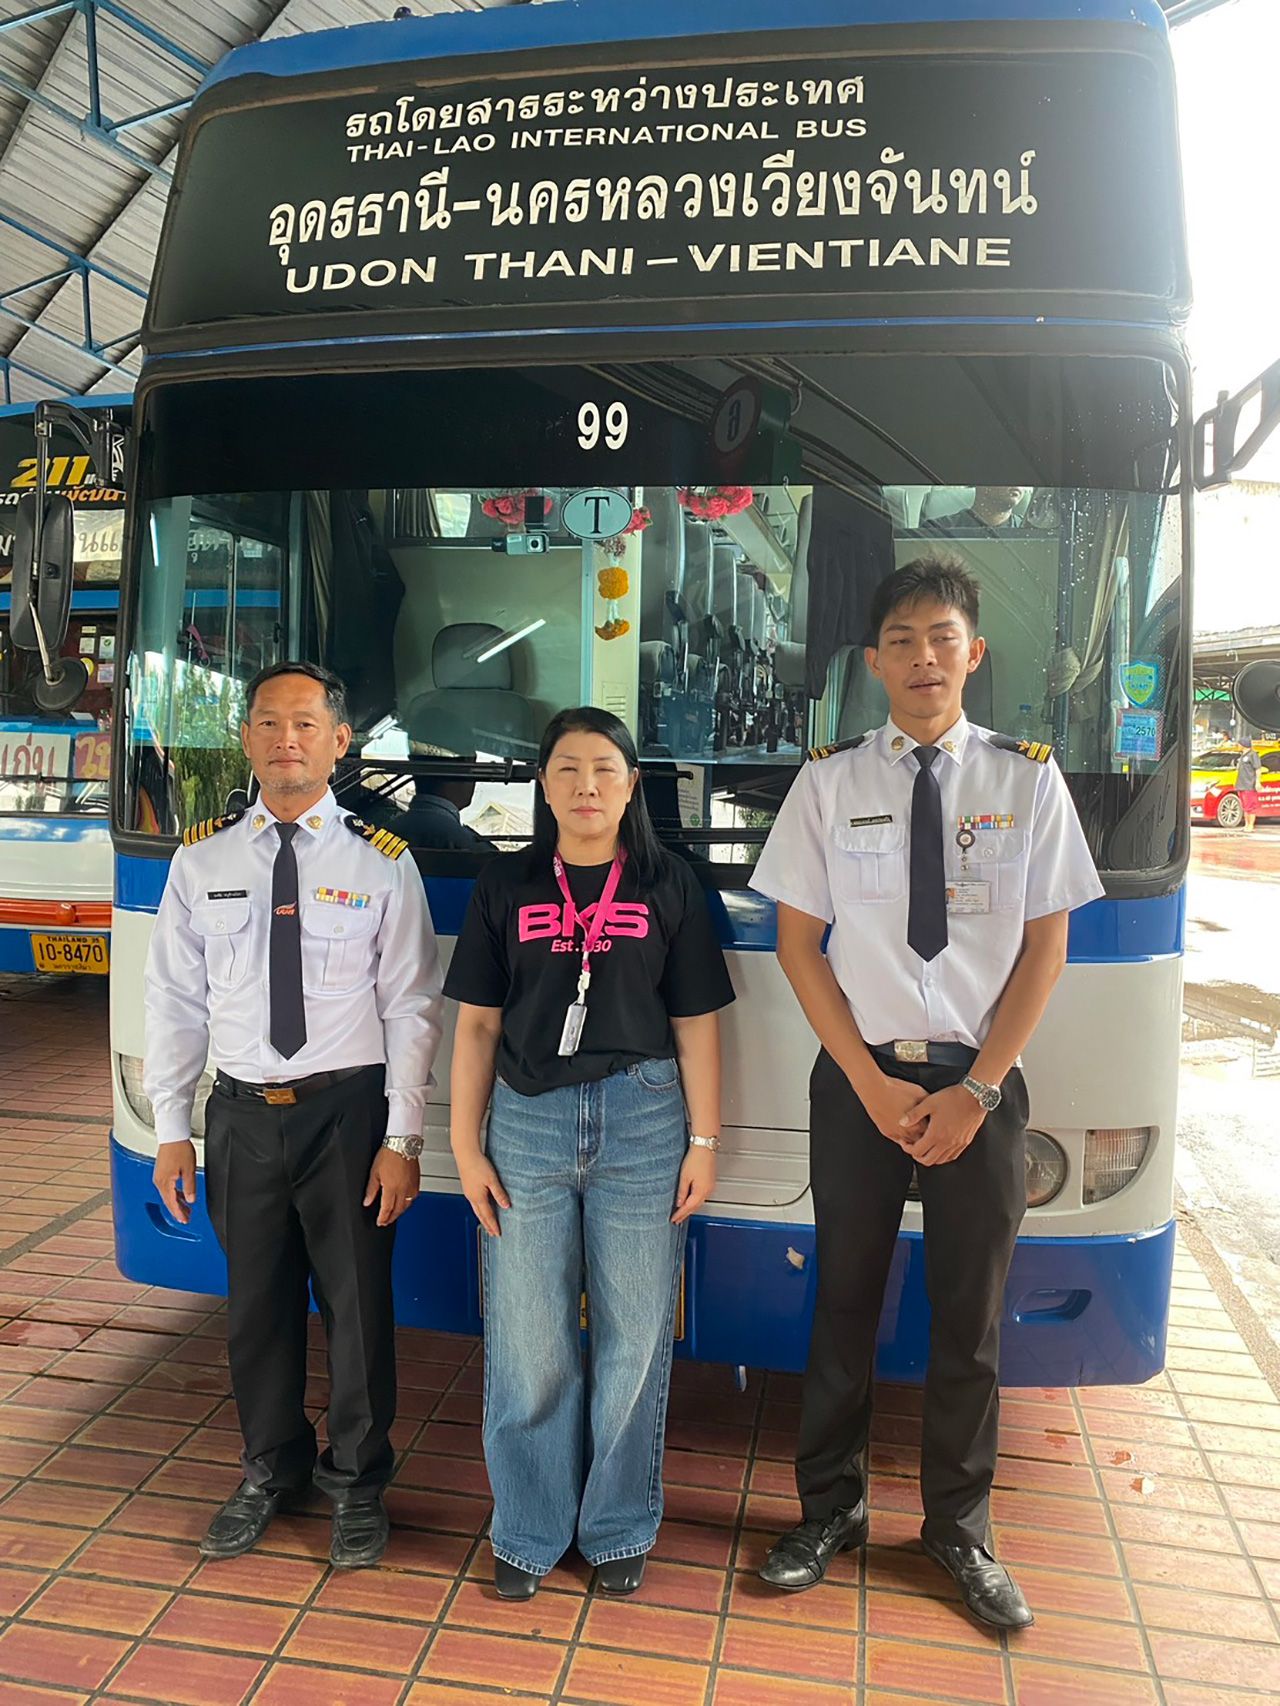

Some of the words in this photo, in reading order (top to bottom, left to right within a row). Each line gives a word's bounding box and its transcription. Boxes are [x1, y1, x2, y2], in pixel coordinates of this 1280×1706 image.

[345, 75, 866, 138] รถโดยสารระหว่างประเทศ
[346, 132, 497, 164] THAI-LAO
[510, 119, 781, 149] INTERNATIONAL
[796, 117, 868, 139] BUS
[285, 256, 438, 294] UDON
[577, 401, 629, 450] 99
[10, 455, 91, 488] 211
[584, 496, 610, 534] T
[1135, 726, 1156, 737] 2570
[518, 902, 649, 943] BKS
[38, 942, 104, 963] 10-8470
